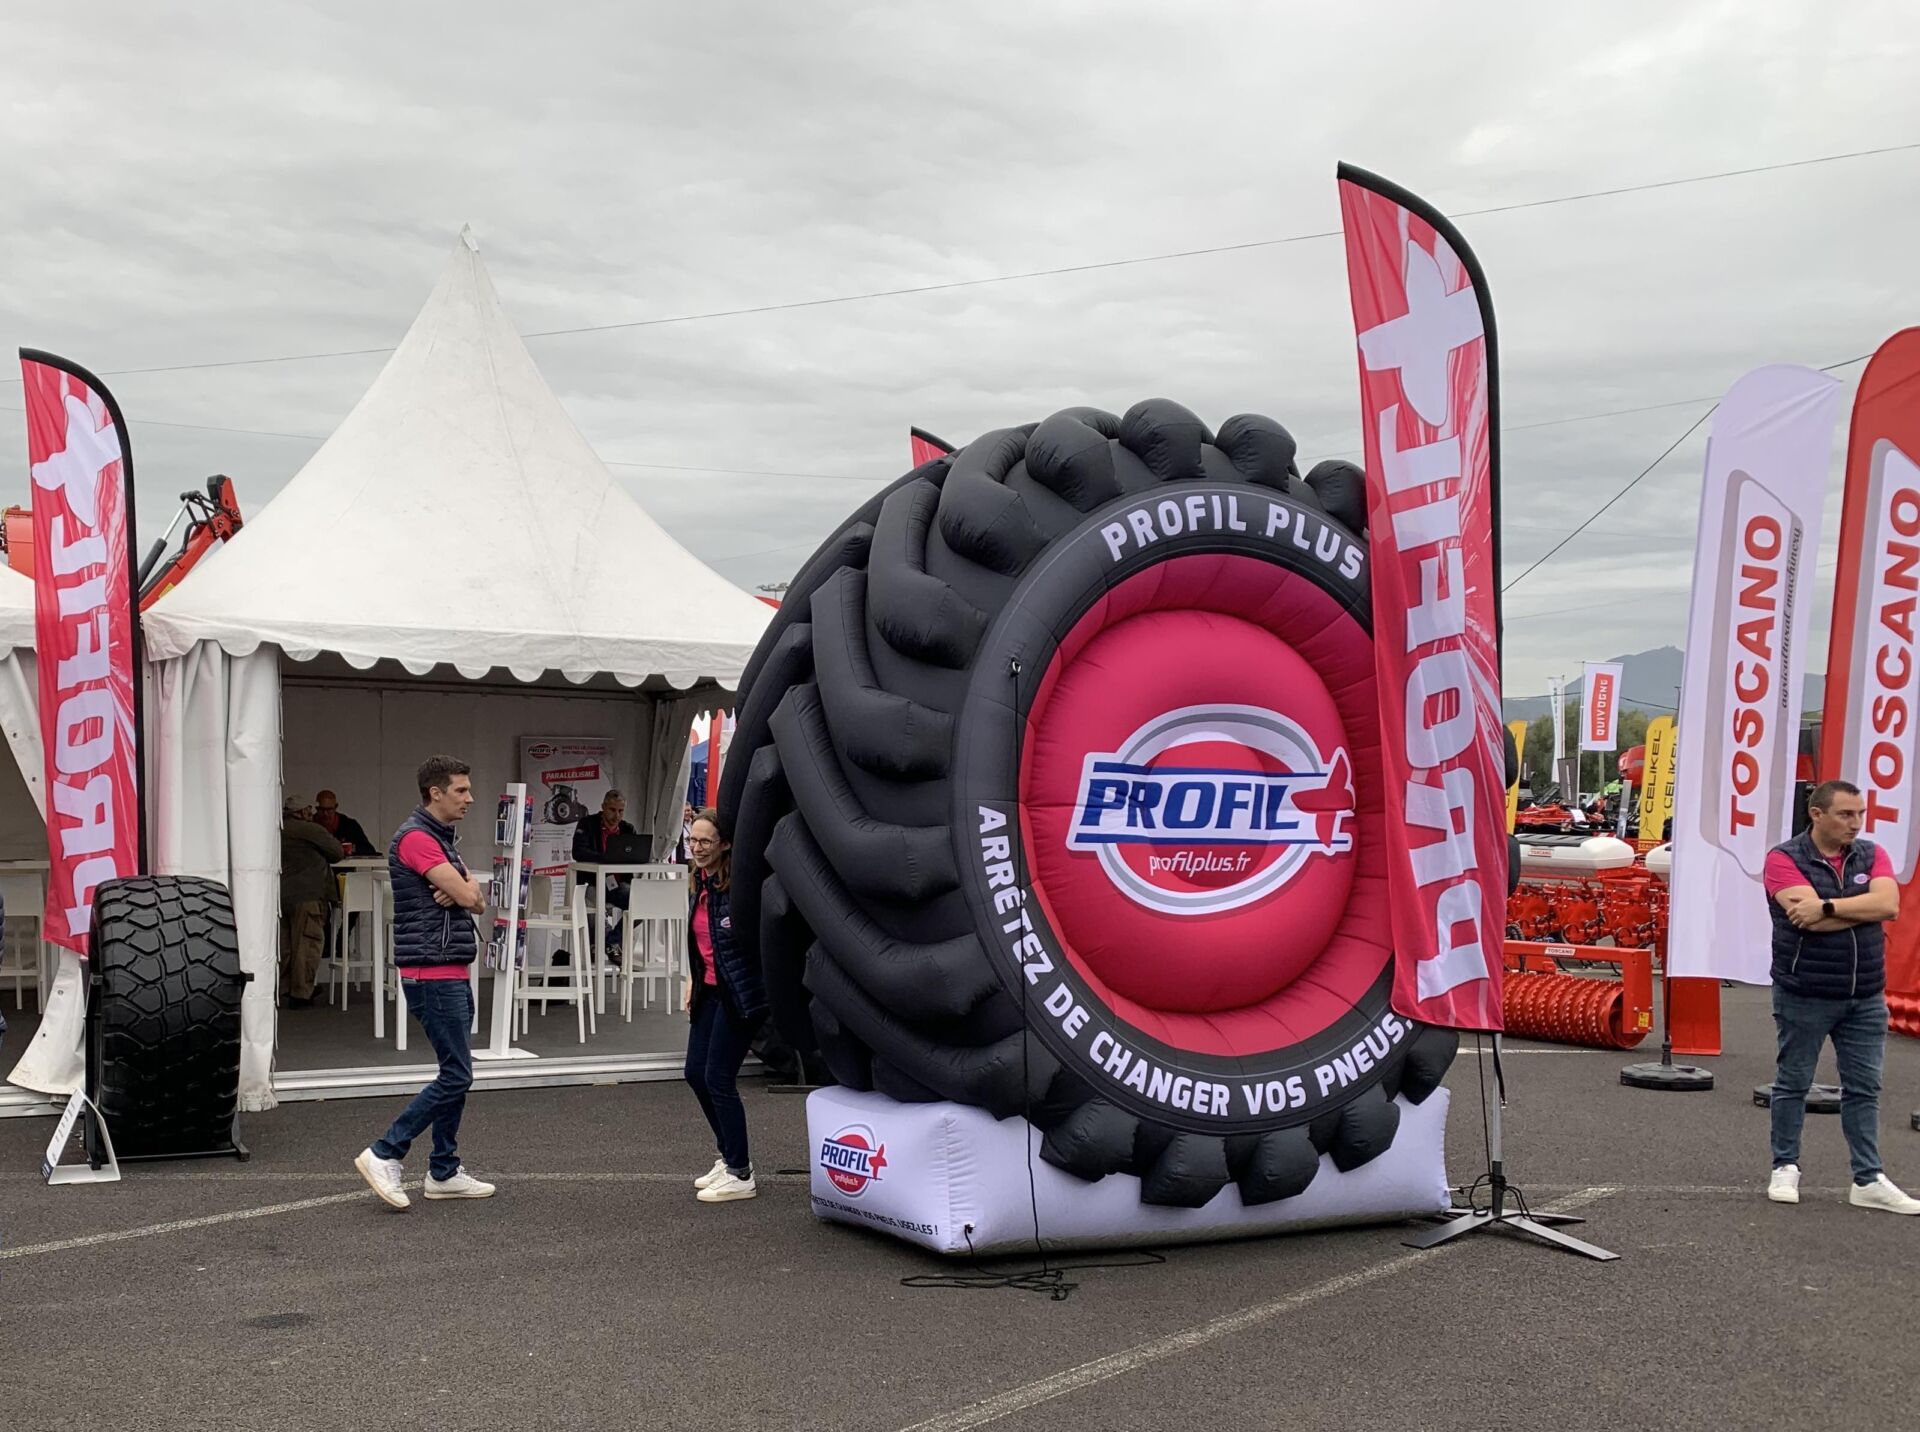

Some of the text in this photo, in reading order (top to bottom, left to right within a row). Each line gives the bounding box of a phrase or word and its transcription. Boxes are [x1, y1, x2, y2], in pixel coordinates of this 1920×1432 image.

[1100, 495, 1364, 580] PROFIL PLUS
[1781, 526, 1802, 709] agricultural machinery
[1730, 515, 1782, 836] TOSCANO
[1866, 488, 1920, 834] TOSCANO
[1079, 778, 1300, 830] PROFIL
[1150, 851, 1251, 877] profilplus.fr
[979, 806, 1054, 985] ARRÊTEZ
[1044, 982, 1090, 1040] DE
[1089, 1031, 1230, 1117] CHANGER
[1242, 1075, 1306, 1116] VOS
[821, 1143, 870, 1173] PROFIL
[934, 1224, 939, 1236] !
